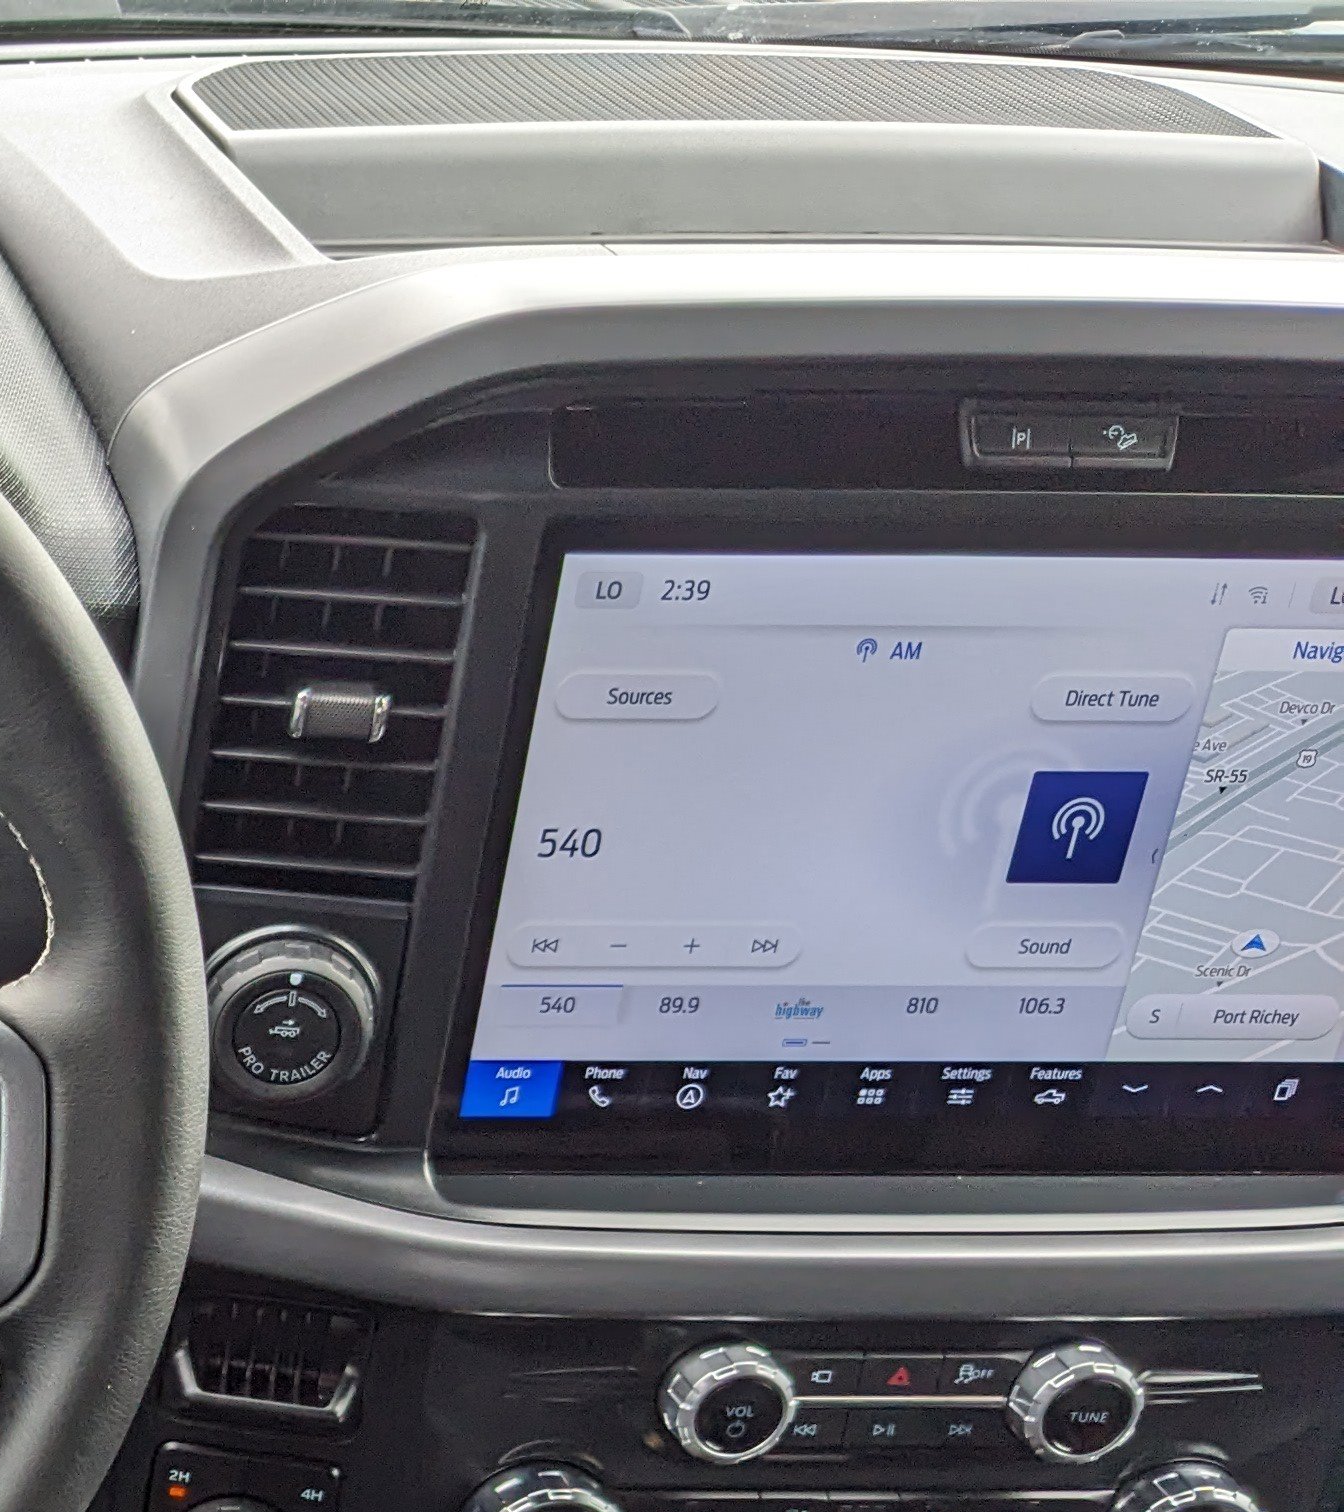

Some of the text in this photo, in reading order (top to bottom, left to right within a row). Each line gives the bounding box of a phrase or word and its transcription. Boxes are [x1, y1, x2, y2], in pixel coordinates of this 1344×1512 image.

[661, 580, 711, 601] 2:39
[890, 642, 922, 660] AM
[607, 687, 672, 706] Sources
[1065, 690, 1160, 707] Direct Tune
[1279, 702, 1335, 714] Devco Dr
[1202, 740, 1227, 751] Ave
[1204, 770, 1248, 783] SR-55
[538, 828, 602, 857] 540
[1018, 939, 1072, 955] Sound
[1195, 965, 1250, 978] Scenic Dr
[538, 997, 576, 1014] 540
[659, 997, 700, 1014] 89.9
[775, 1002, 824, 1019] highway
[906, 997, 939, 1014] 810
[1018, 998, 1066, 1014] 106.3
[1149, 1009, 1161, 1024] S
[1212, 1008, 1300, 1027] Port Richey
[238, 1046, 332, 1083] PRO TRAILER
[496, 1066, 532, 1080] Audio
[585, 1066, 624, 1080] Phone
[683, 1066, 707, 1080] Nav
[774, 1066, 799, 1080] Fav
[860, 1067, 892, 1083] Apps
[941, 1067, 992, 1082] Settings
[1030, 1067, 1082, 1080] Features
[973, 1368, 995, 1379] OFF
[726, 1406, 754, 1418] VOL
[1069, 1411, 1109, 1424] TUNE
[168, 1470, 191, 1483] 2H
[300, 1488, 324, 1502] 4H
